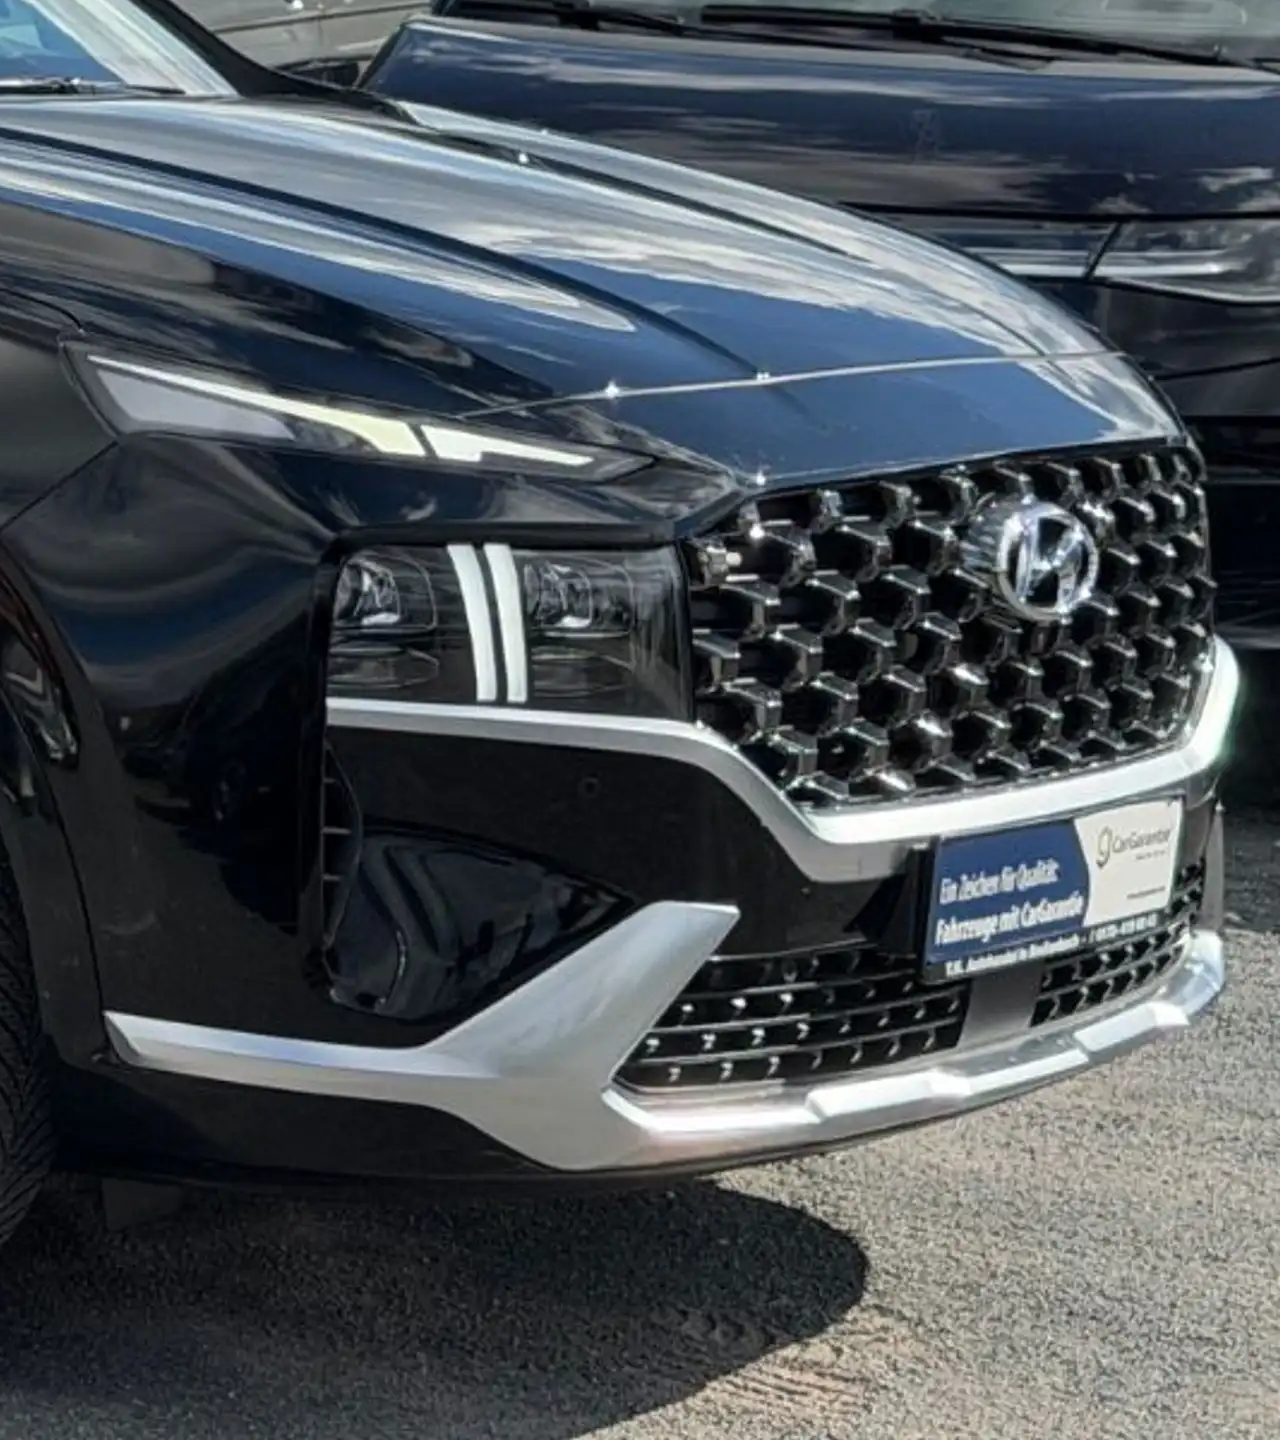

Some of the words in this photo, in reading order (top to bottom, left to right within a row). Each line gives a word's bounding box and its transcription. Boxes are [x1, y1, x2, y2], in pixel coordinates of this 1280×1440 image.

[939, 877, 957, 905] Ein
[959, 871, 1000, 901] Zeichen
[999, 866, 1016, 892] für
[935, 913, 998, 946] Fahrzeuge
[999, 904, 1020, 932] mit
[1021, 890, 1084, 927] CarGarantie
